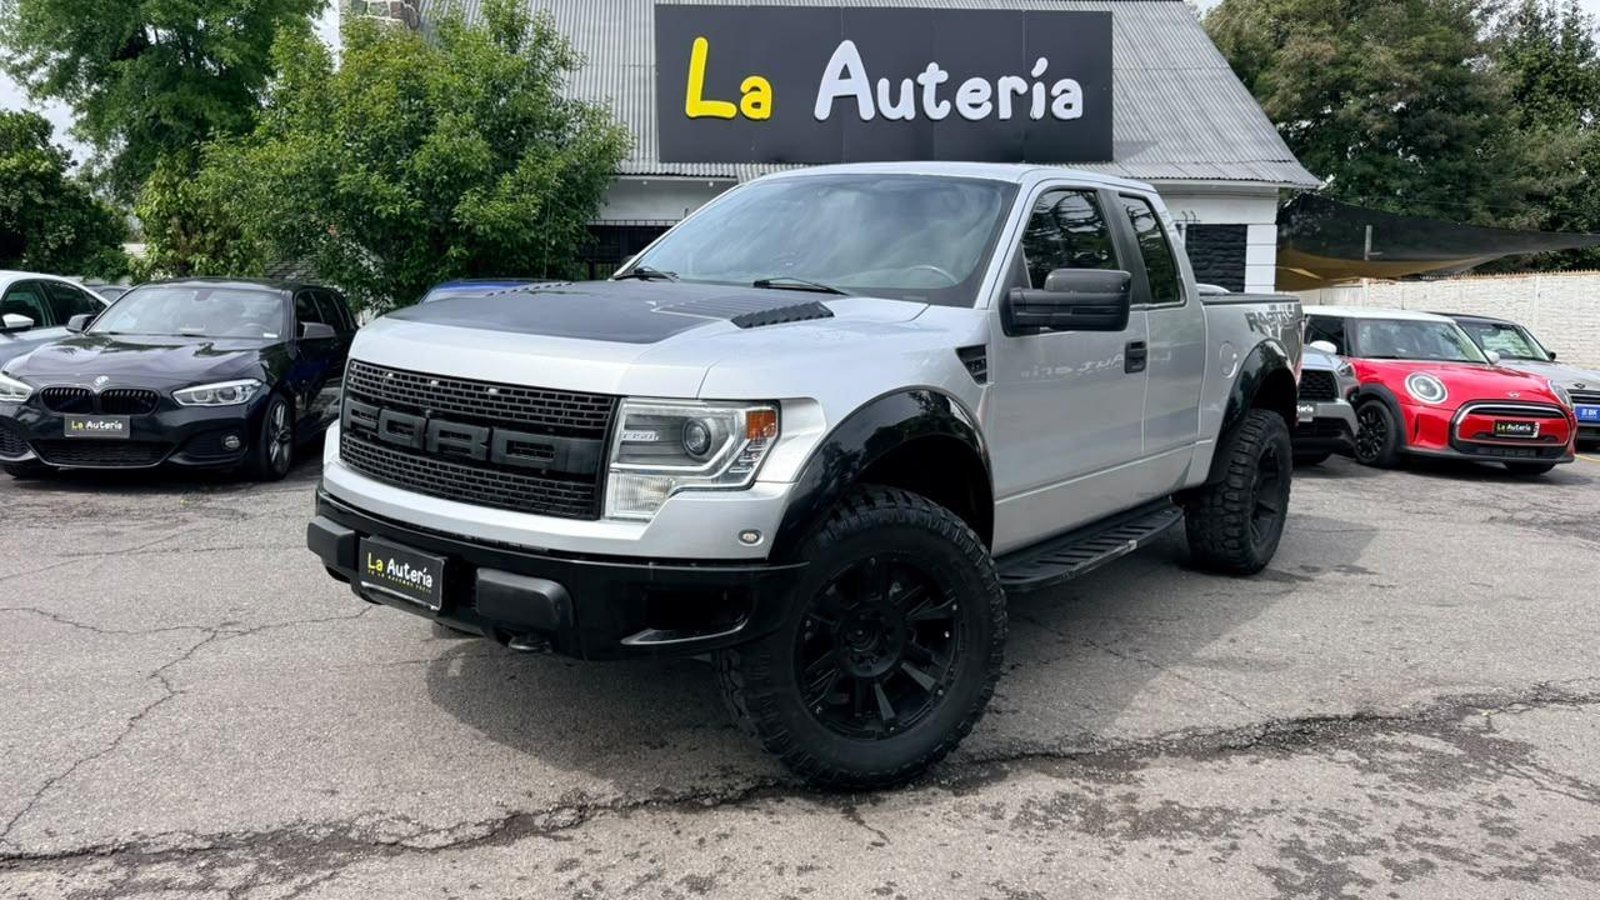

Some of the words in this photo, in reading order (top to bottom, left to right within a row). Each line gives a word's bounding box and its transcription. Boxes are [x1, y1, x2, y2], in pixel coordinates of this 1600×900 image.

[685, 36, 773, 119] La
[814, 39, 1083, 120] Autería
[72, 421, 83, 429] La
[86, 420, 122, 430] Autería
[343, 398, 582, 474] FORD
[1497, 423, 1505, 431] La
[368, 552, 383, 572] La
[387, 558, 433, 588] Autería
